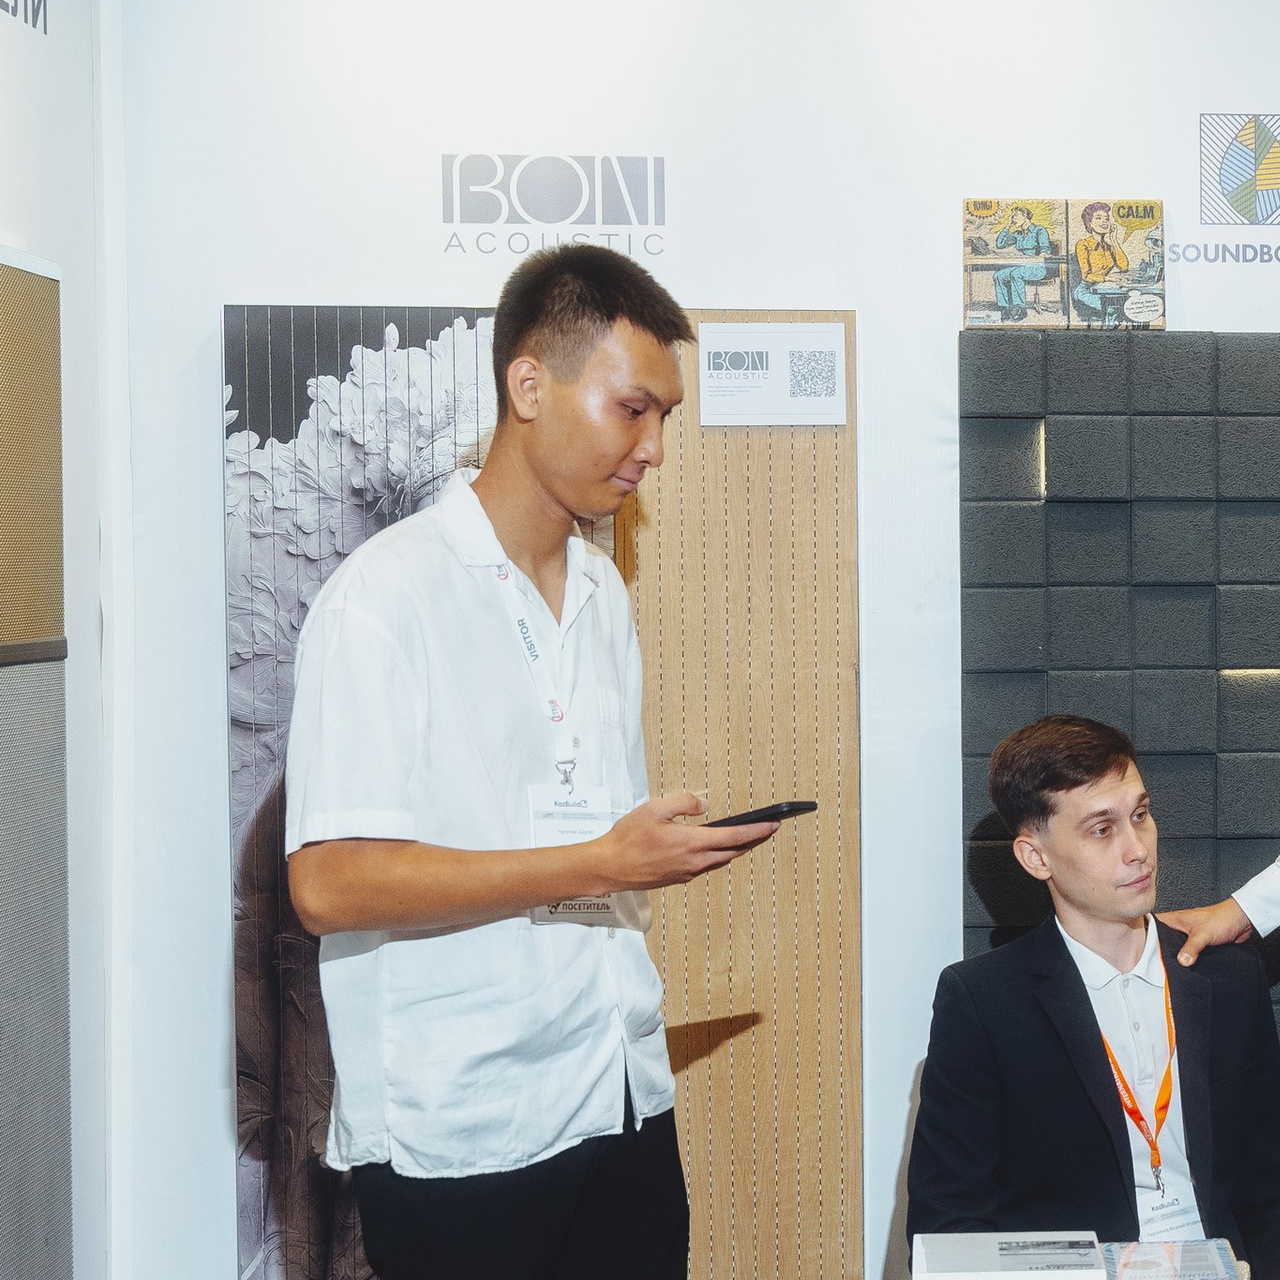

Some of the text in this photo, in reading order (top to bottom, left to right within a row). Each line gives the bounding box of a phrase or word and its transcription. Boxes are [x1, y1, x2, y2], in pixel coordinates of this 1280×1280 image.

[441, 154, 666, 227] BONI
[1116, 205, 1156, 220] CALM
[707, 350, 769, 372] BONI
[707, 372, 769, 380] ACOUSTIC
[517, 617, 539, 663] VISITOR
